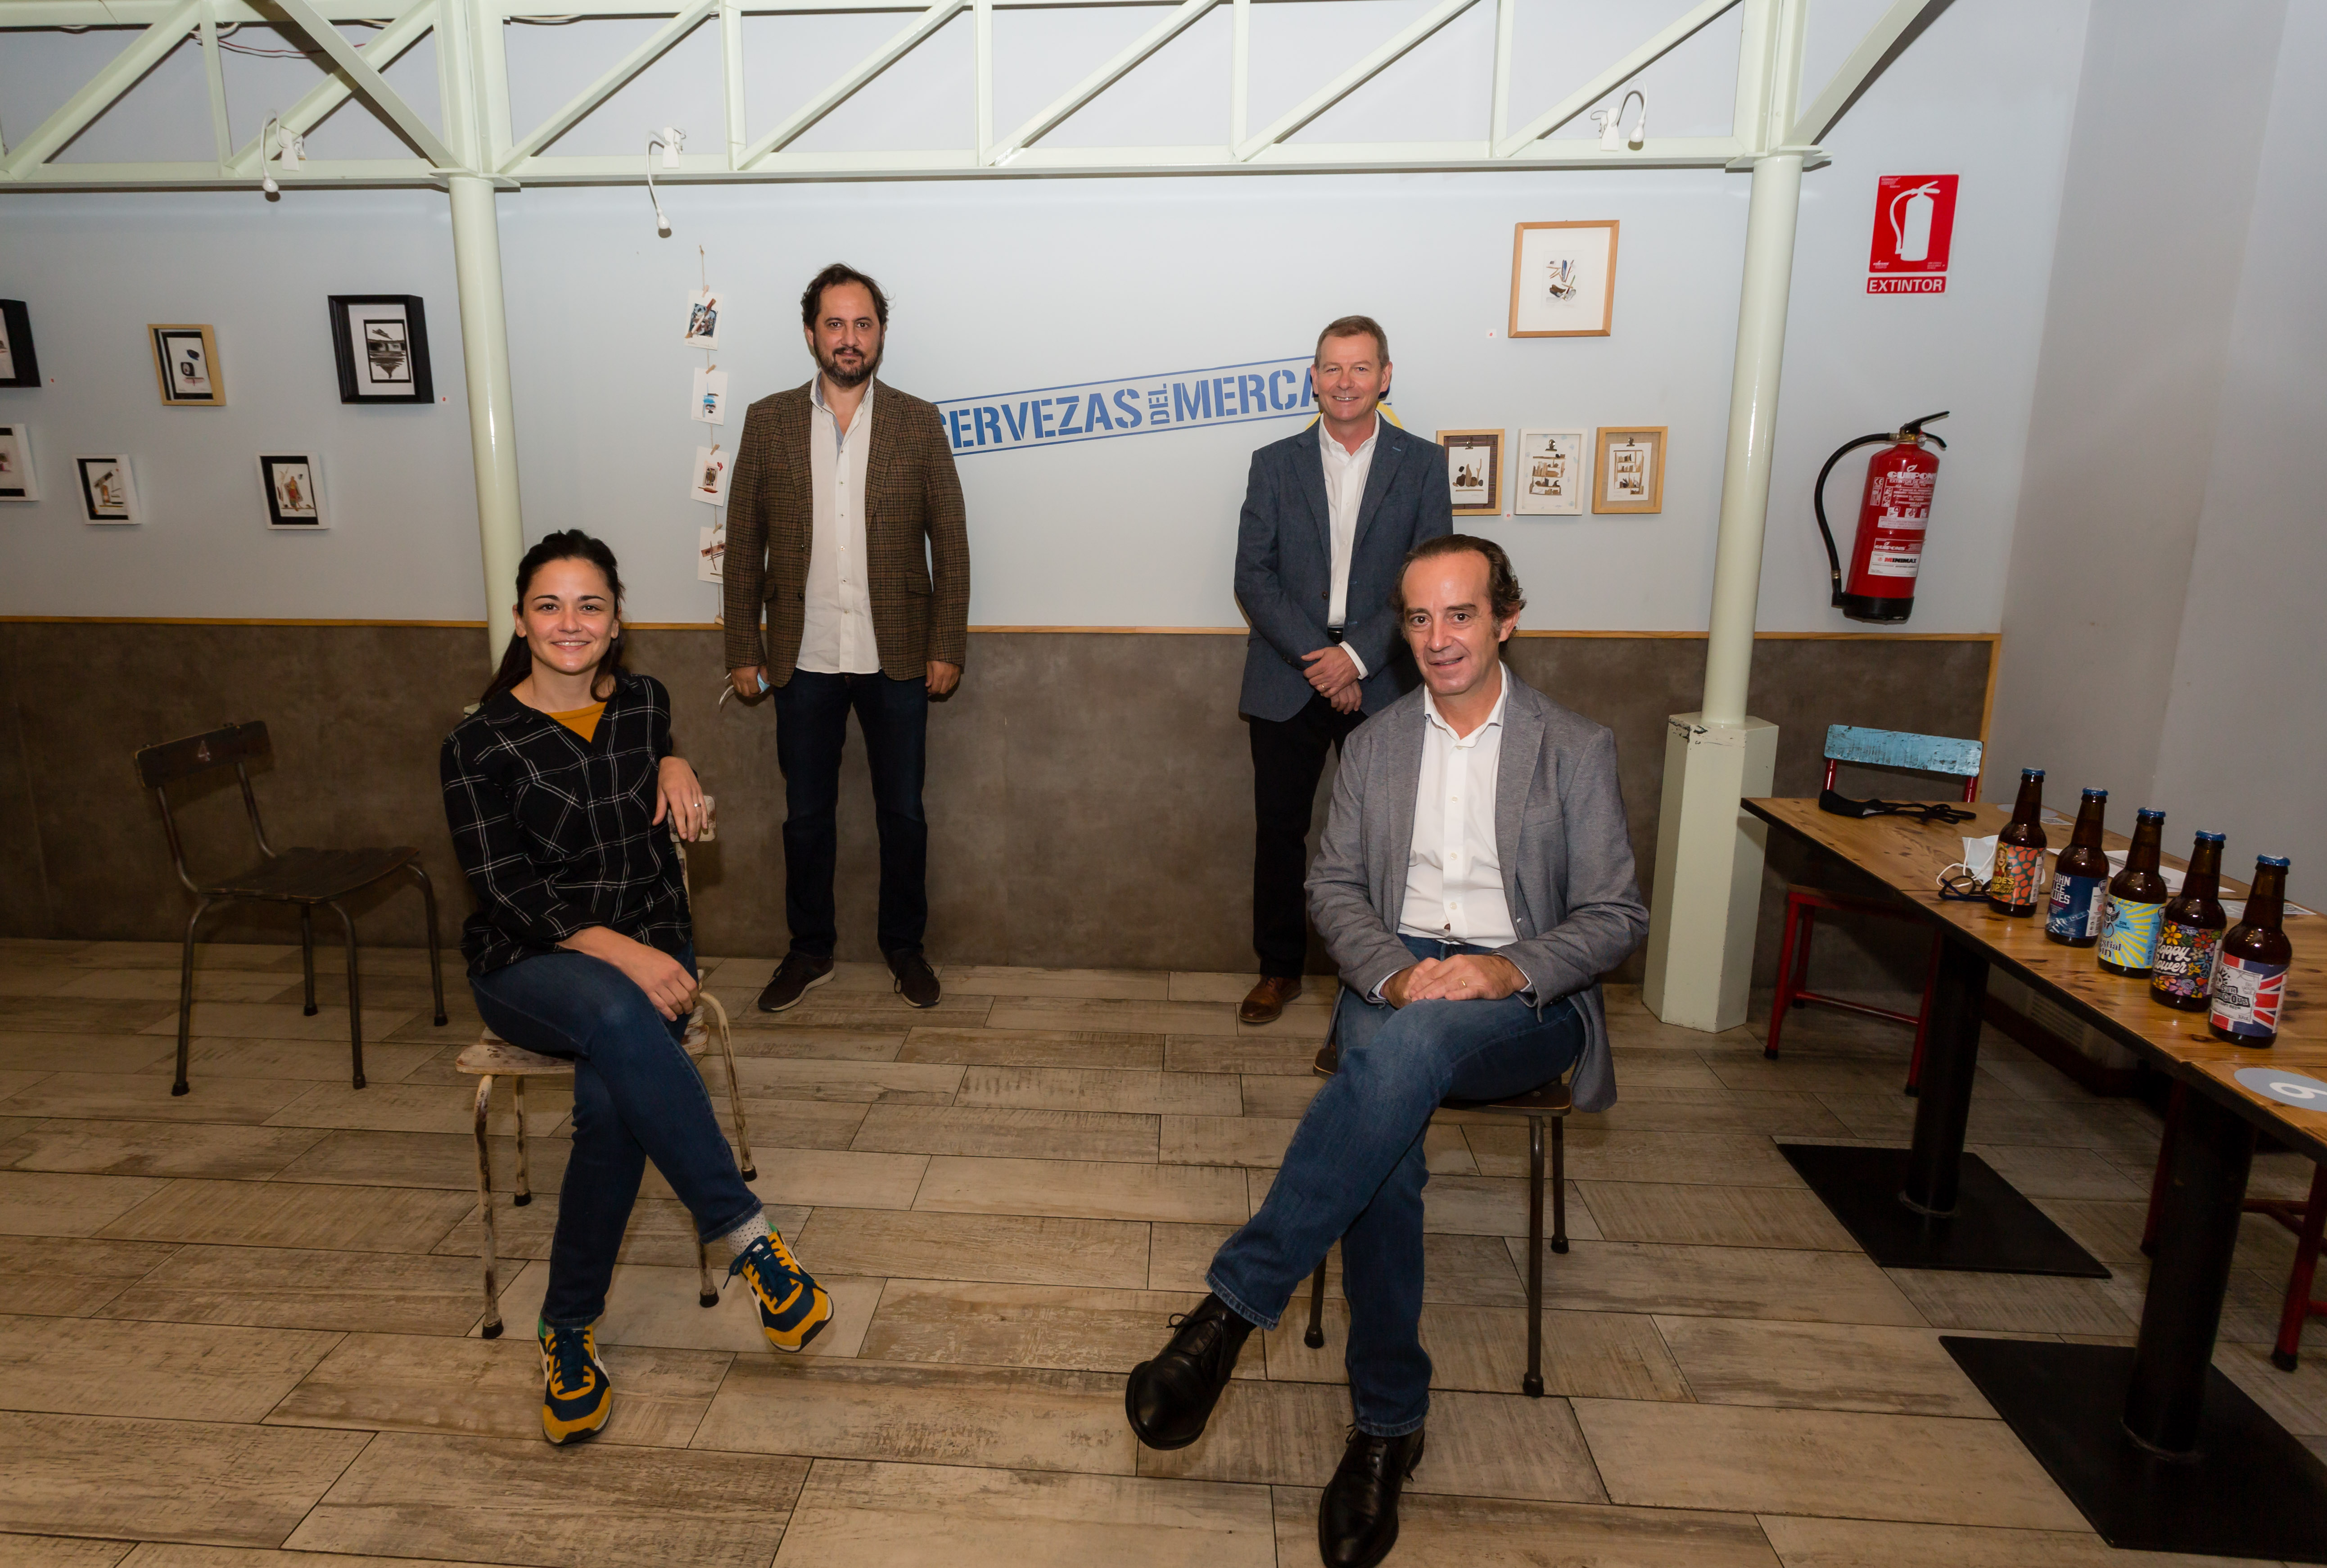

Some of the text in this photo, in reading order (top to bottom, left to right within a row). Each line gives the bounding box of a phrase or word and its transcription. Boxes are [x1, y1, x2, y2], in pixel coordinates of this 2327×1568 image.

[1869, 279, 1943, 292] EXTINTOR
[940, 389, 1143, 448] ERVEZAS
[1148, 383, 1170, 425] DEL
[1887, 471, 1936, 480] GUIPON
[2053, 881, 2066, 894] LEE
